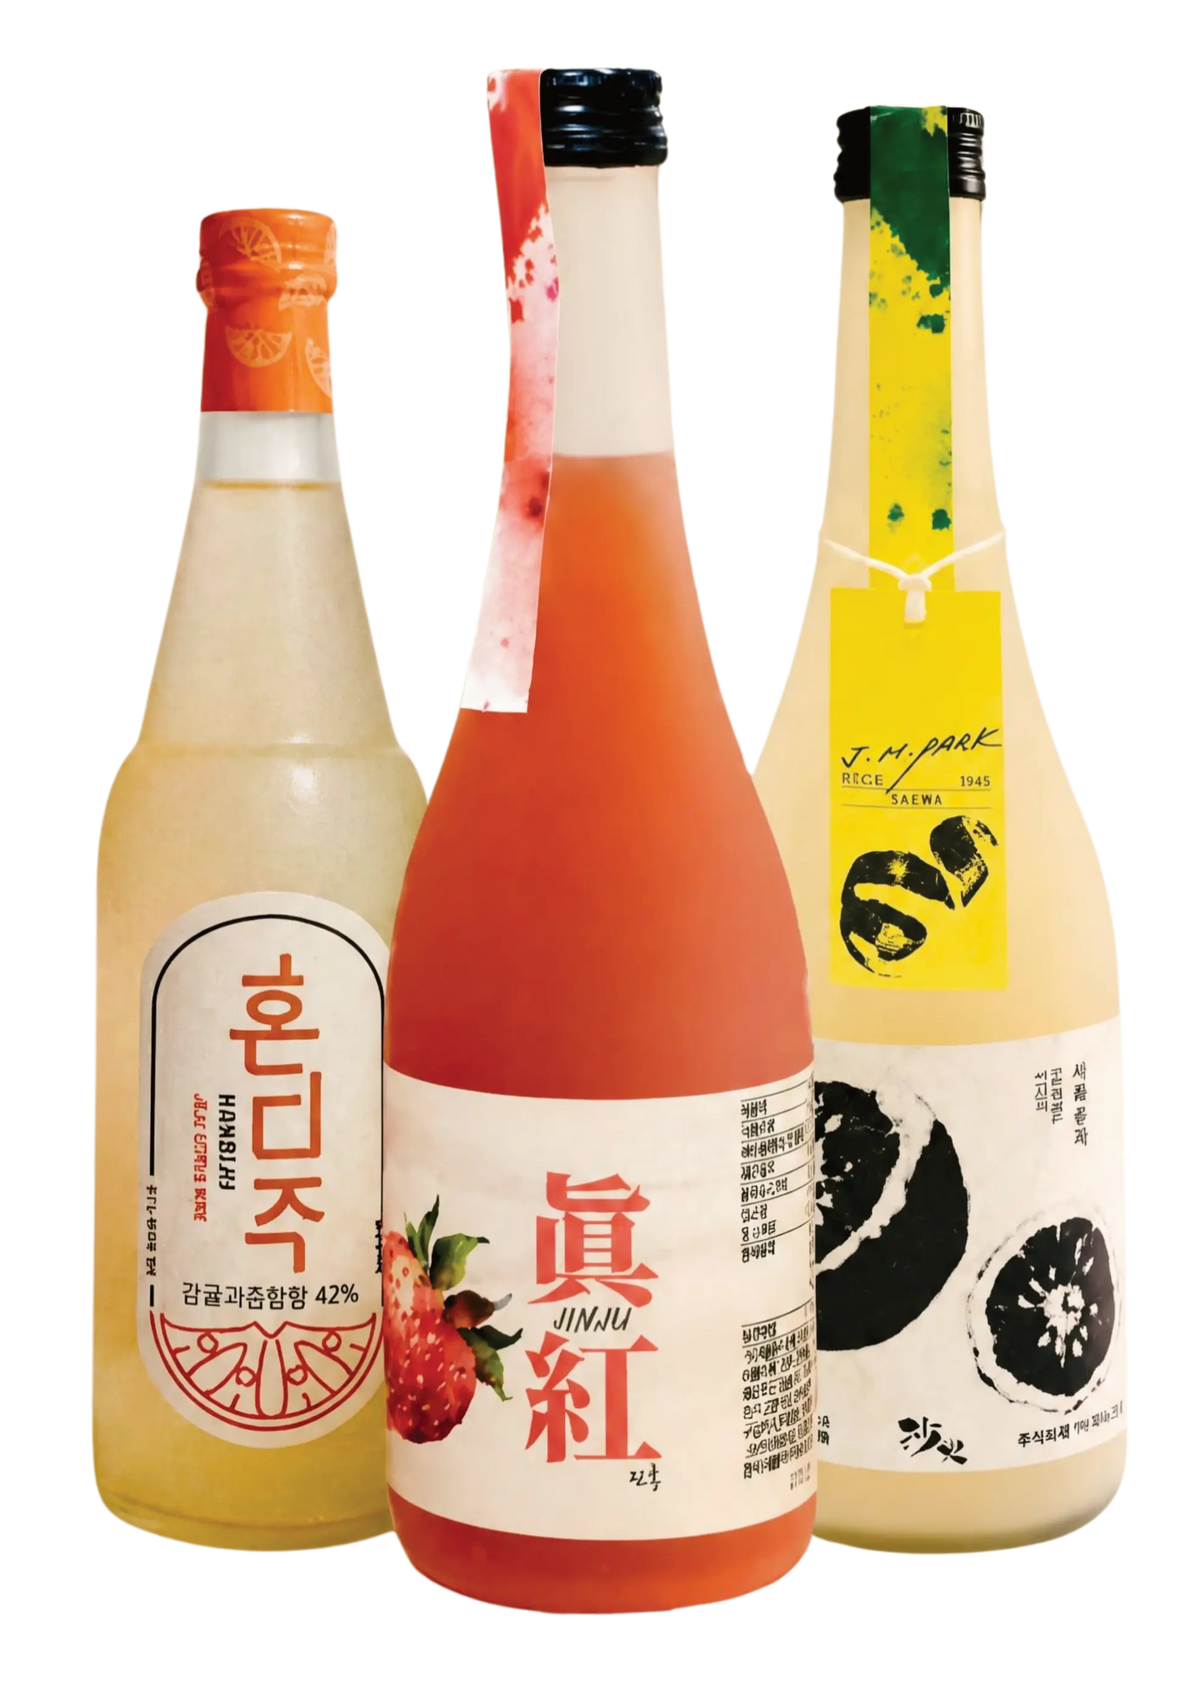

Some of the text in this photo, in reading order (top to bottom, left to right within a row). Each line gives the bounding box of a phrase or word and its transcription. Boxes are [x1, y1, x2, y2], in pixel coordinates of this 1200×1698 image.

[960, 775, 990, 787] 1945
[891, 793, 942, 805] SAEWA
[229, 952, 325, 1274] 혼디주
[314, 1283, 360, 1306] 42%
[525, 1330, 662, 1463] 紅
